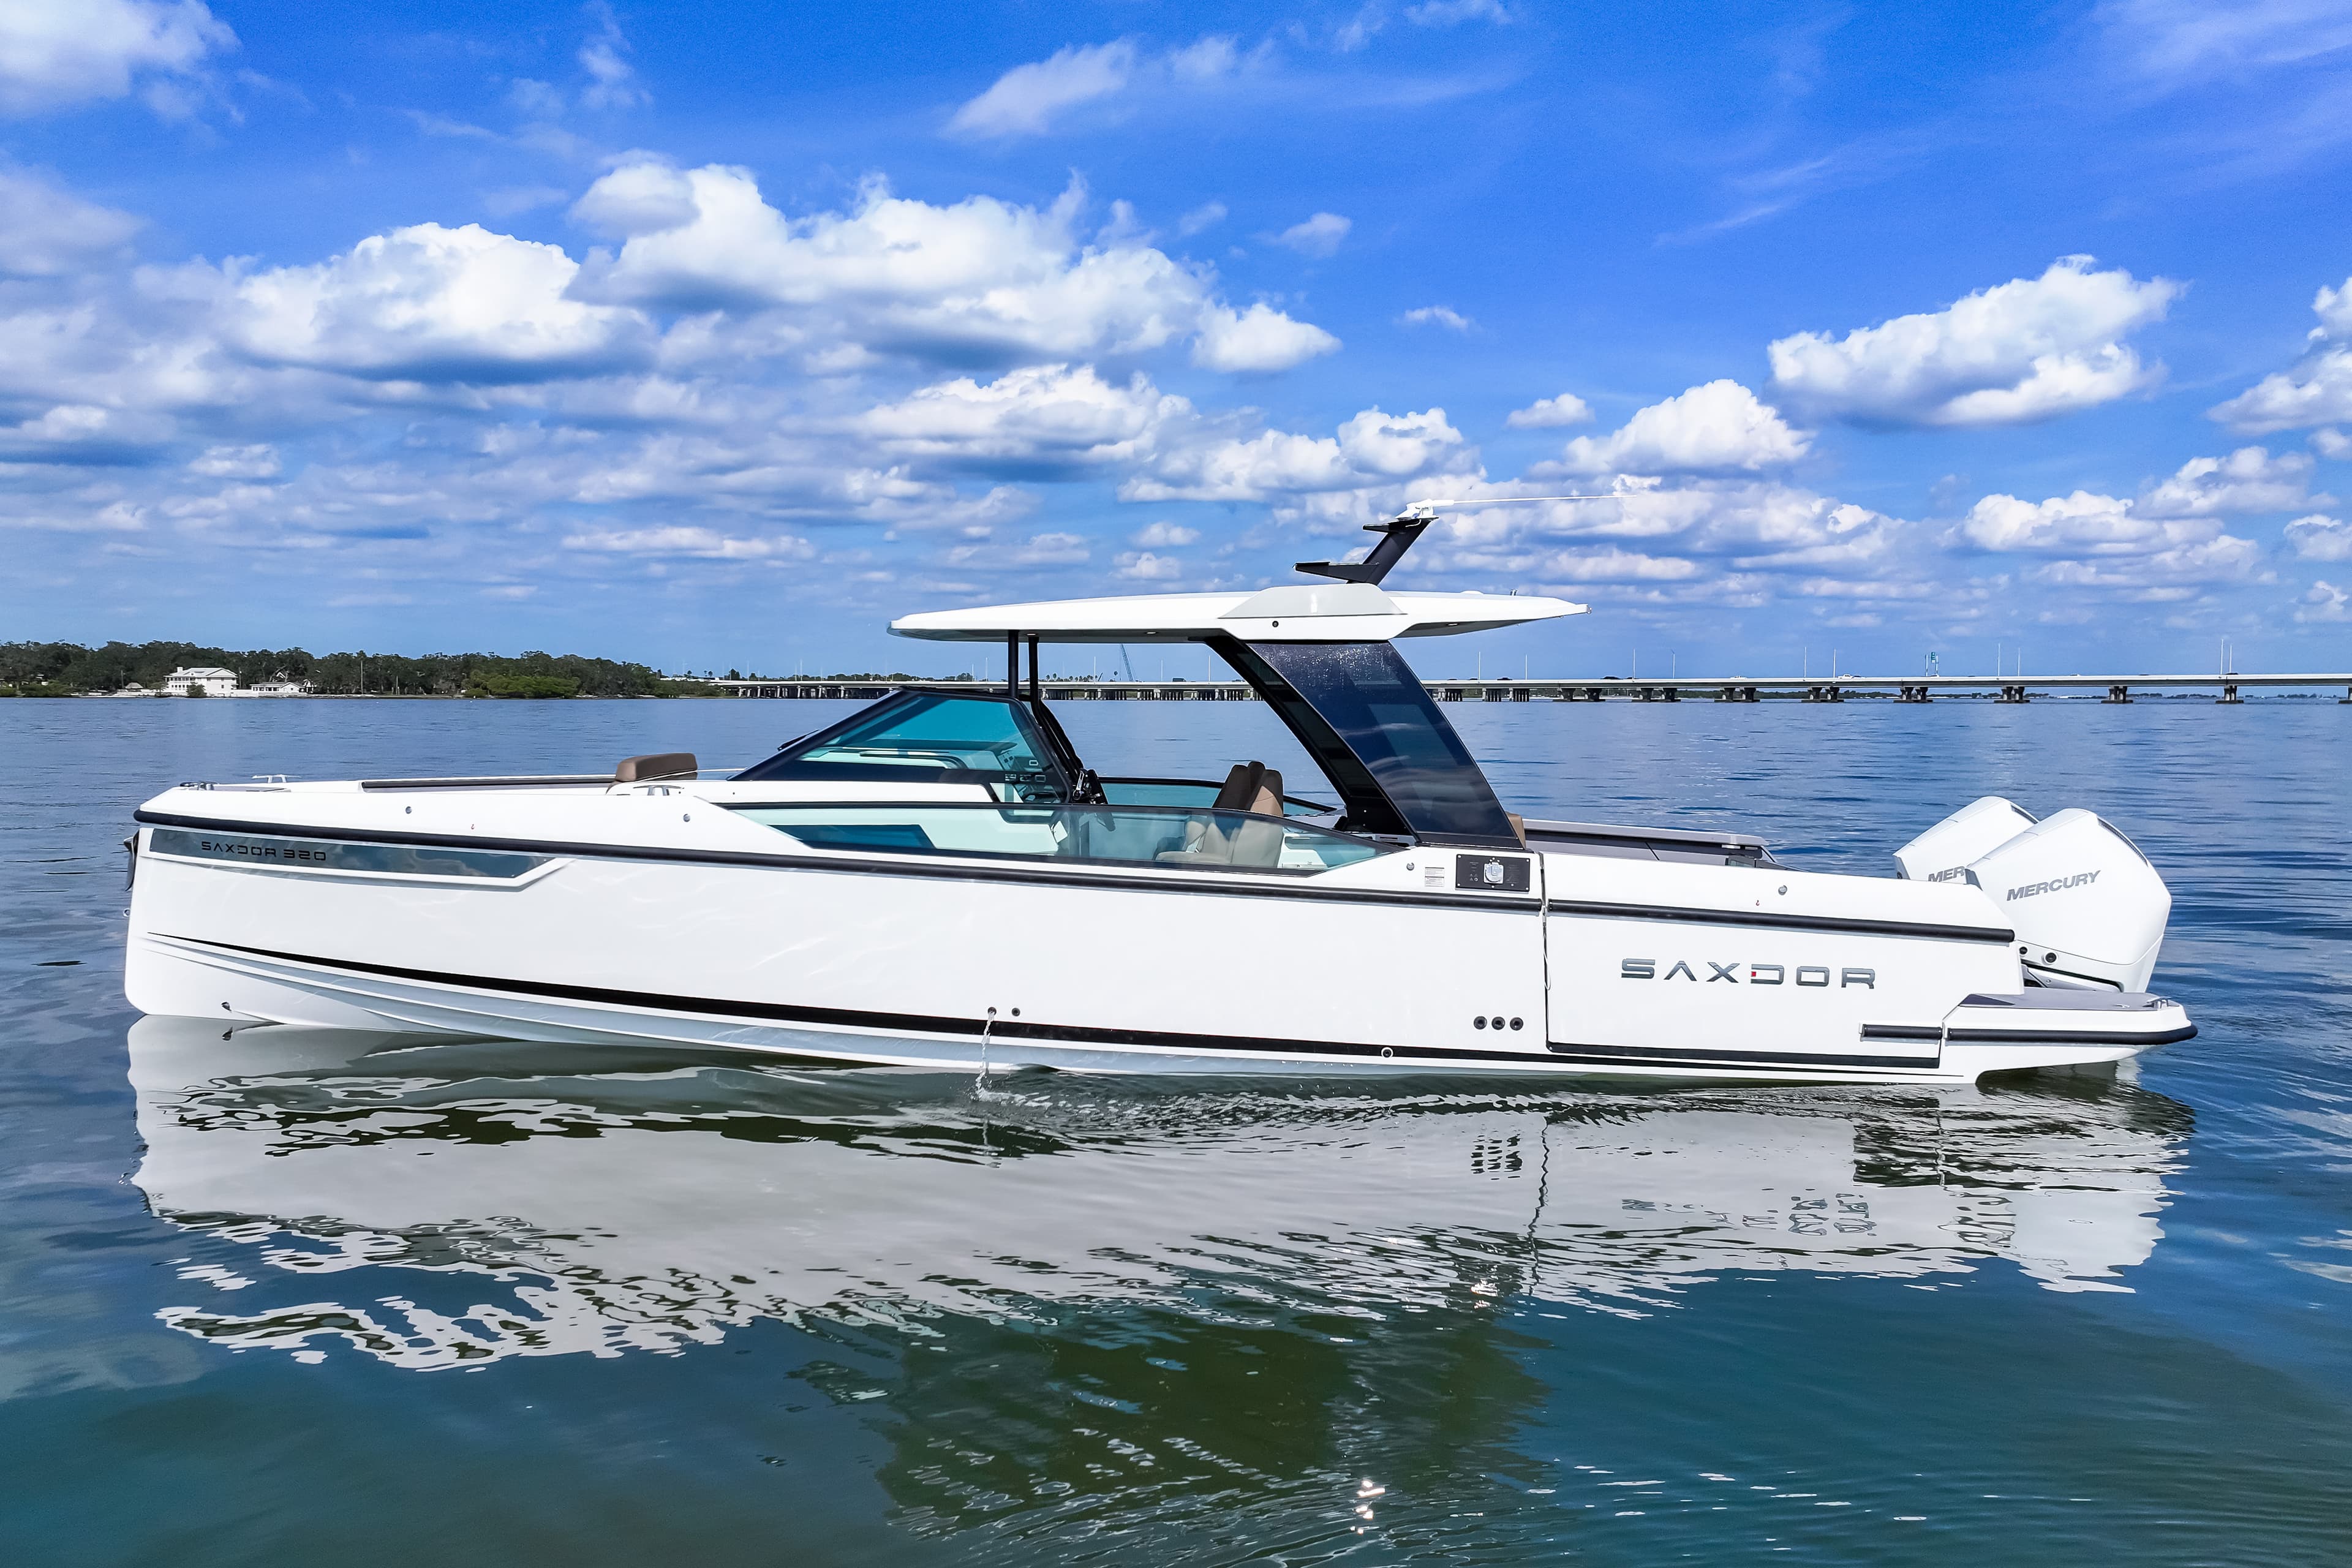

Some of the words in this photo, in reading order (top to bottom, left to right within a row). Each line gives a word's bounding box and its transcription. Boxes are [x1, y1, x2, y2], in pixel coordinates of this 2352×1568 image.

[201, 841, 277, 858] SAXDOR
[284, 849, 326, 861] 320
[2006, 870, 2101, 902] MERCURY
[1621, 958, 1875, 990] SAXDOR
